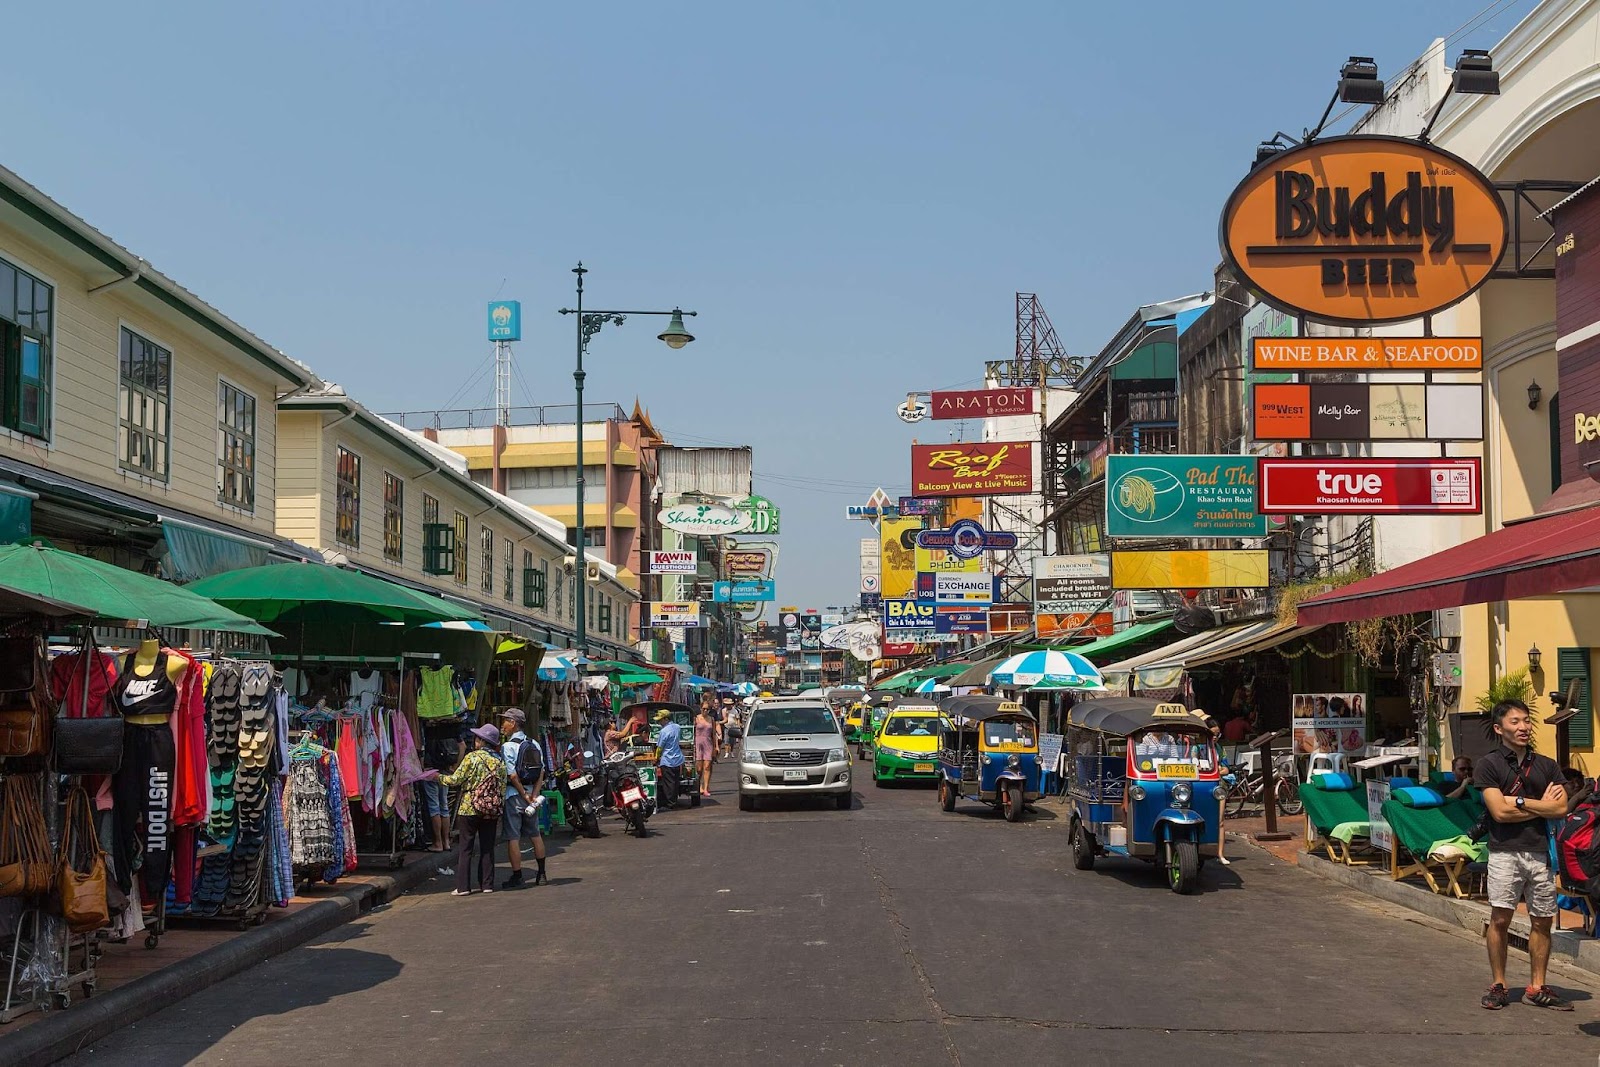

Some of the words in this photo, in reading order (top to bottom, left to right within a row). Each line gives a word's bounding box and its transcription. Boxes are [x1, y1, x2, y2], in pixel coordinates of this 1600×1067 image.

[1274, 170, 1454, 253] Buddy
[1321, 258, 1417, 287] BEER
[492, 327, 511, 336] KTB
[1258, 346, 1312, 362] WINE
[1316, 346, 1357, 362] BAR
[1363, 346, 1379, 362] &
[1384, 346, 1478, 362] SEAFOOD
[940, 393, 1026, 409] ARATON
[1344, 404, 1361, 415] Bar
[928, 445, 1009, 471] Roof
[953, 466, 991, 478] Bar
[1186, 465, 1221, 485] Pad
[918, 482, 951, 491] Balcony
[952, 482, 972, 490] View
[974, 481, 983, 489] &
[985, 480, 1001, 488] Live
[1003, 479, 1027, 488] Music
[1316, 469, 1382, 495] true
[1197, 495, 1215, 503] Khao
[1216, 495, 1233, 503] Sarn
[1234, 495, 1252, 503] Road
[667, 511, 740, 526] Shamrock
[1196, 508, 1253, 520] ร้านผัดไทย
[771, 510, 779, 533] INN
[922, 532, 953, 545] Center
[957, 534, 984, 546] Point
[654, 552, 692, 564] KAWIN
[930, 549, 945, 560] ID
[930, 561, 965, 569] PHOTO
[938, 582, 991, 590] EXCHANGE
[1074, 584, 1111, 592] breakfas
[919, 590, 935, 598] UOB
[888, 601, 934, 617] BAG
[905, 619, 915, 627] Trip
[916, 618, 934, 626] Station
[1013, 617, 1029, 625] ATM
[126, 679, 158, 695] NIKE
[1160, 705, 1182, 714] TAXI
[148, 766, 168, 809] JUST
[147, 810, 168, 835] DO
[146, 835, 167, 853] IT.
